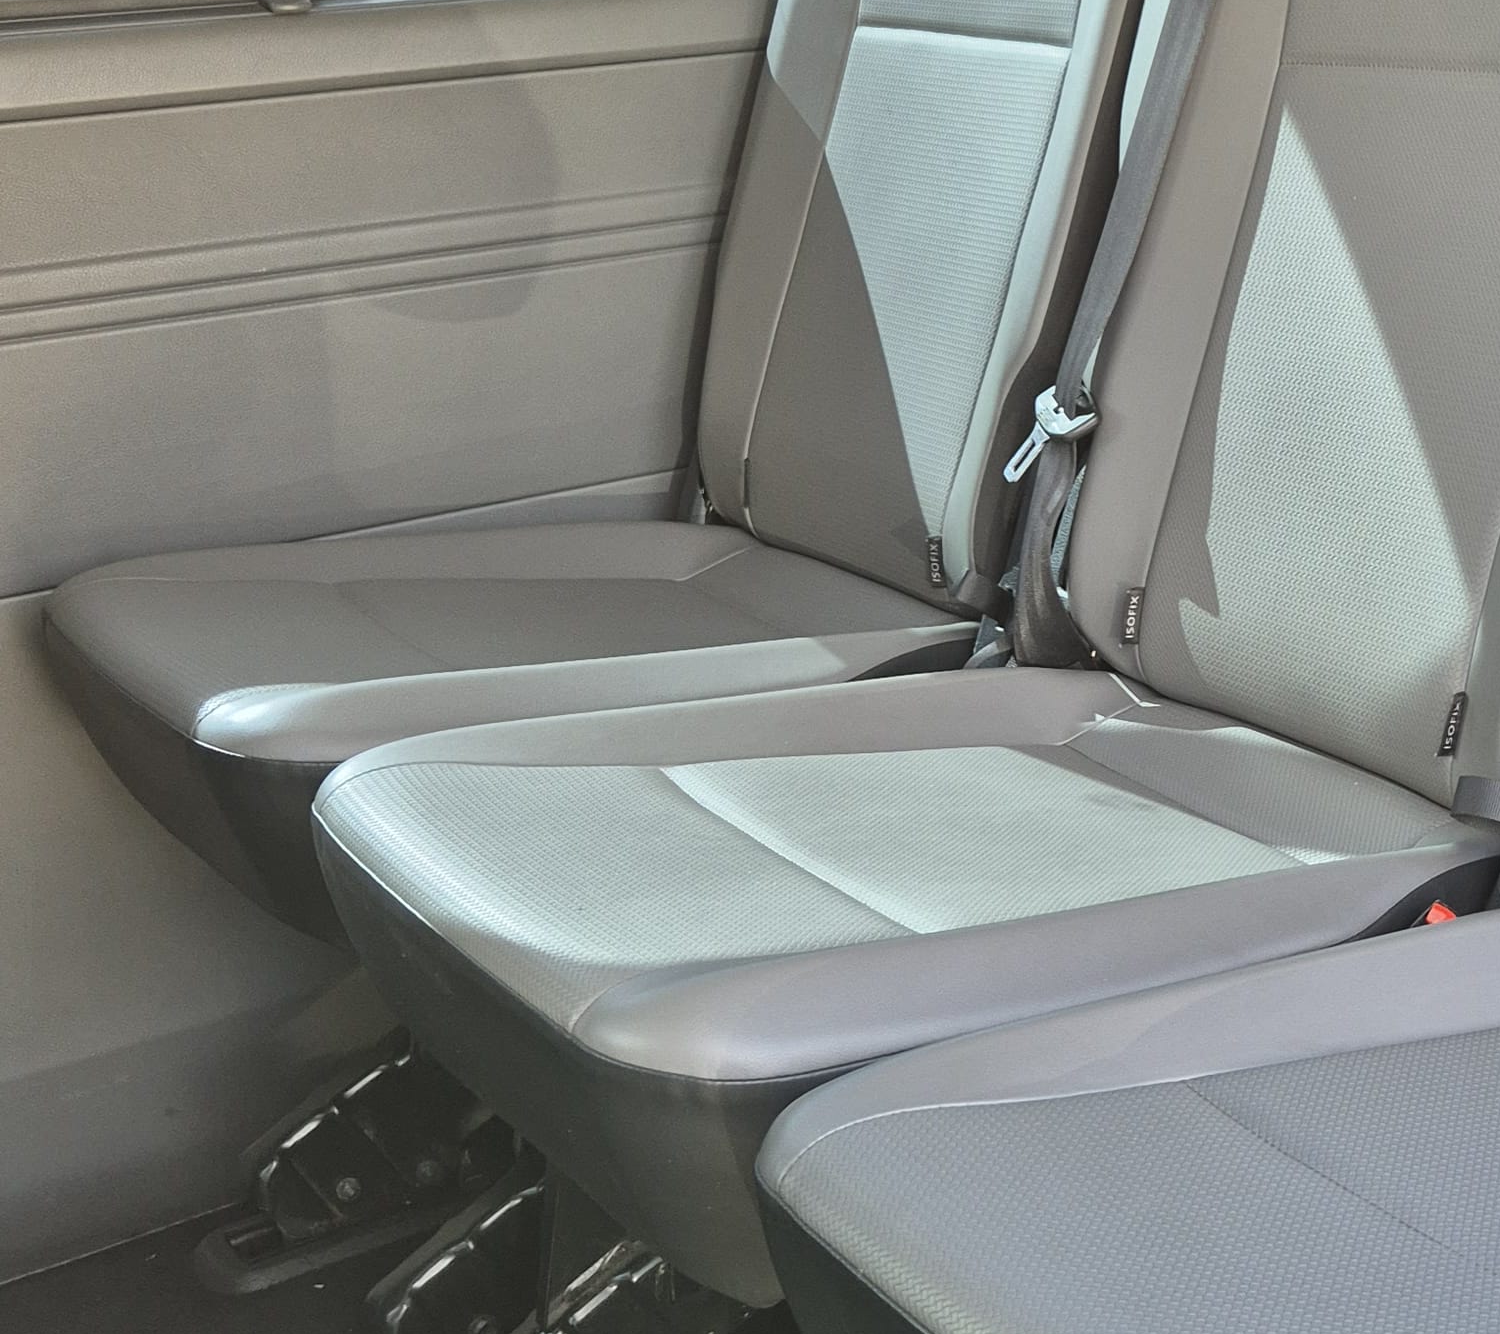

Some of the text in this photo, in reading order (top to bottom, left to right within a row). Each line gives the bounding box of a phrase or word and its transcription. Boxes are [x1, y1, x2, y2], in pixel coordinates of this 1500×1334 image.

[930, 543, 941, 582] ISOFIX
[1125, 596, 1140, 638] ISOFIX
[1443, 700, 1462, 749] ISOFIX
